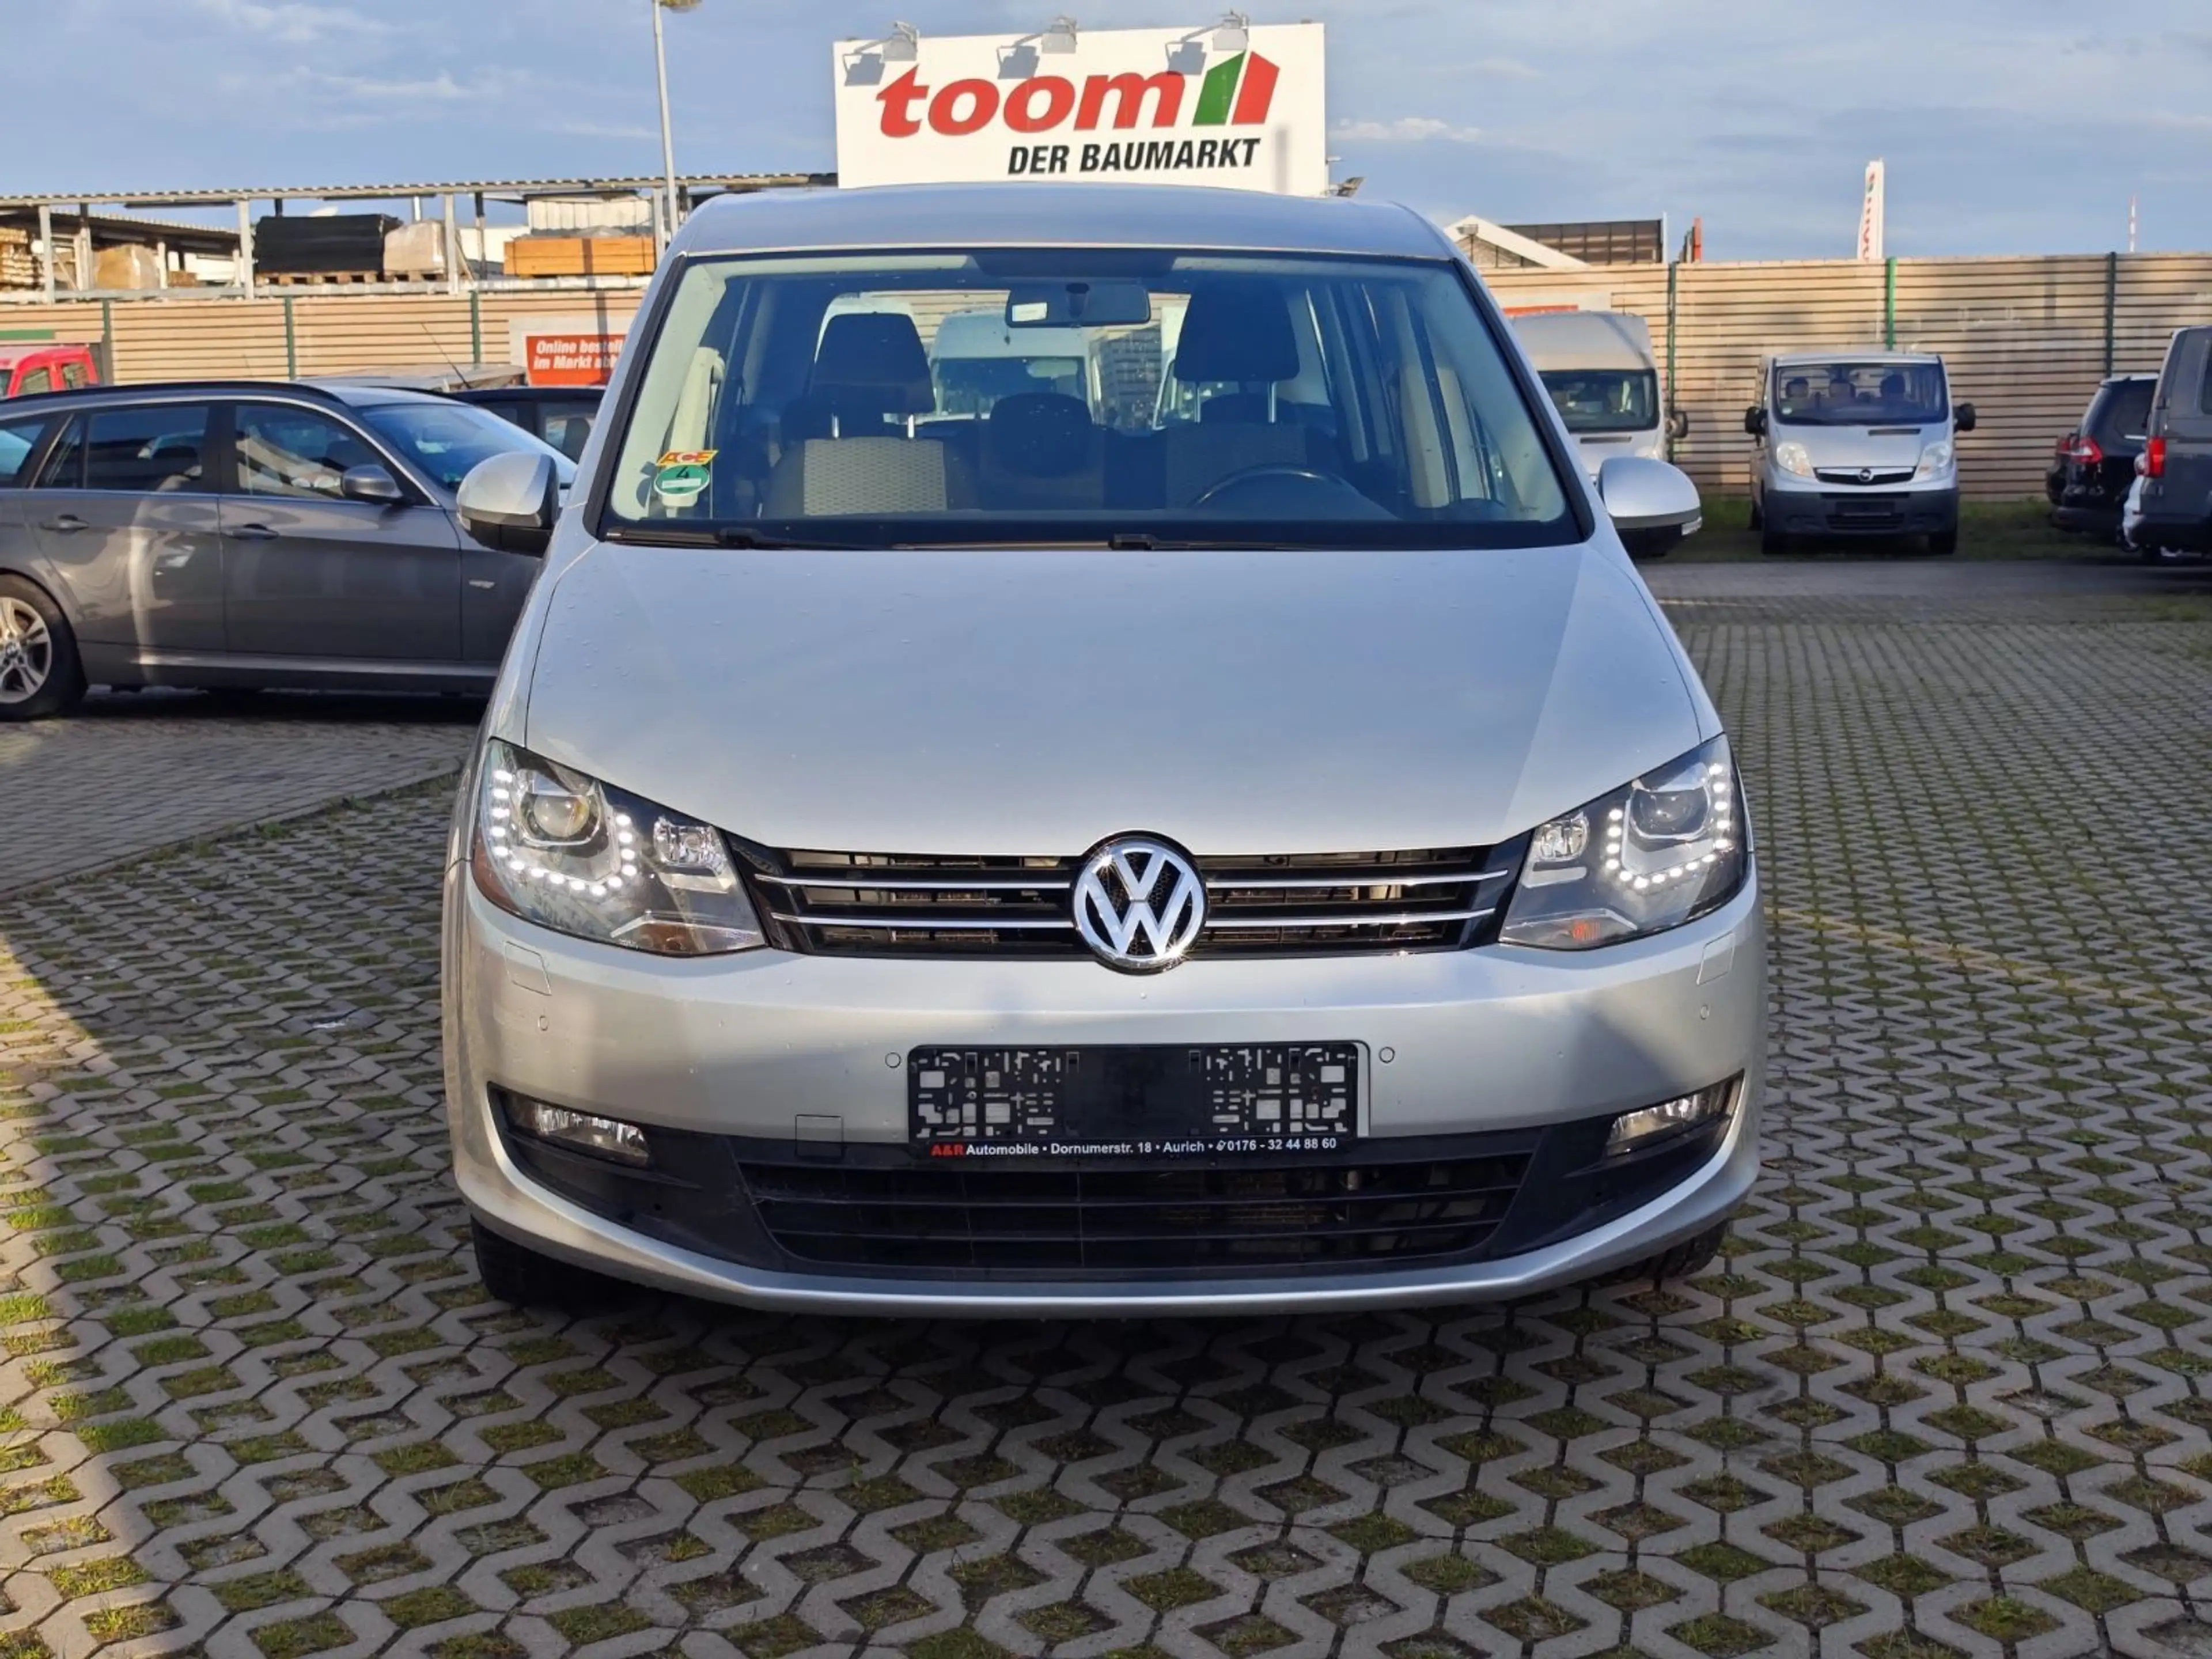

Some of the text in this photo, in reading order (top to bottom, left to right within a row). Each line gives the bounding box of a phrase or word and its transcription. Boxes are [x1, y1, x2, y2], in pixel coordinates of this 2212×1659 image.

[875, 65, 1185, 139] toom
[1007, 138, 1261, 175] DER BAUMARKT
[536, 340, 577, 354] Online
[533, 355, 551, 369] im
[554, 355, 593, 369] Markt
[676, 466, 690, 479] 4
[931, 1138, 1337, 1156] A&R Automobile Dornumerstr. 18 Aurich 0176 32 44 88 60
